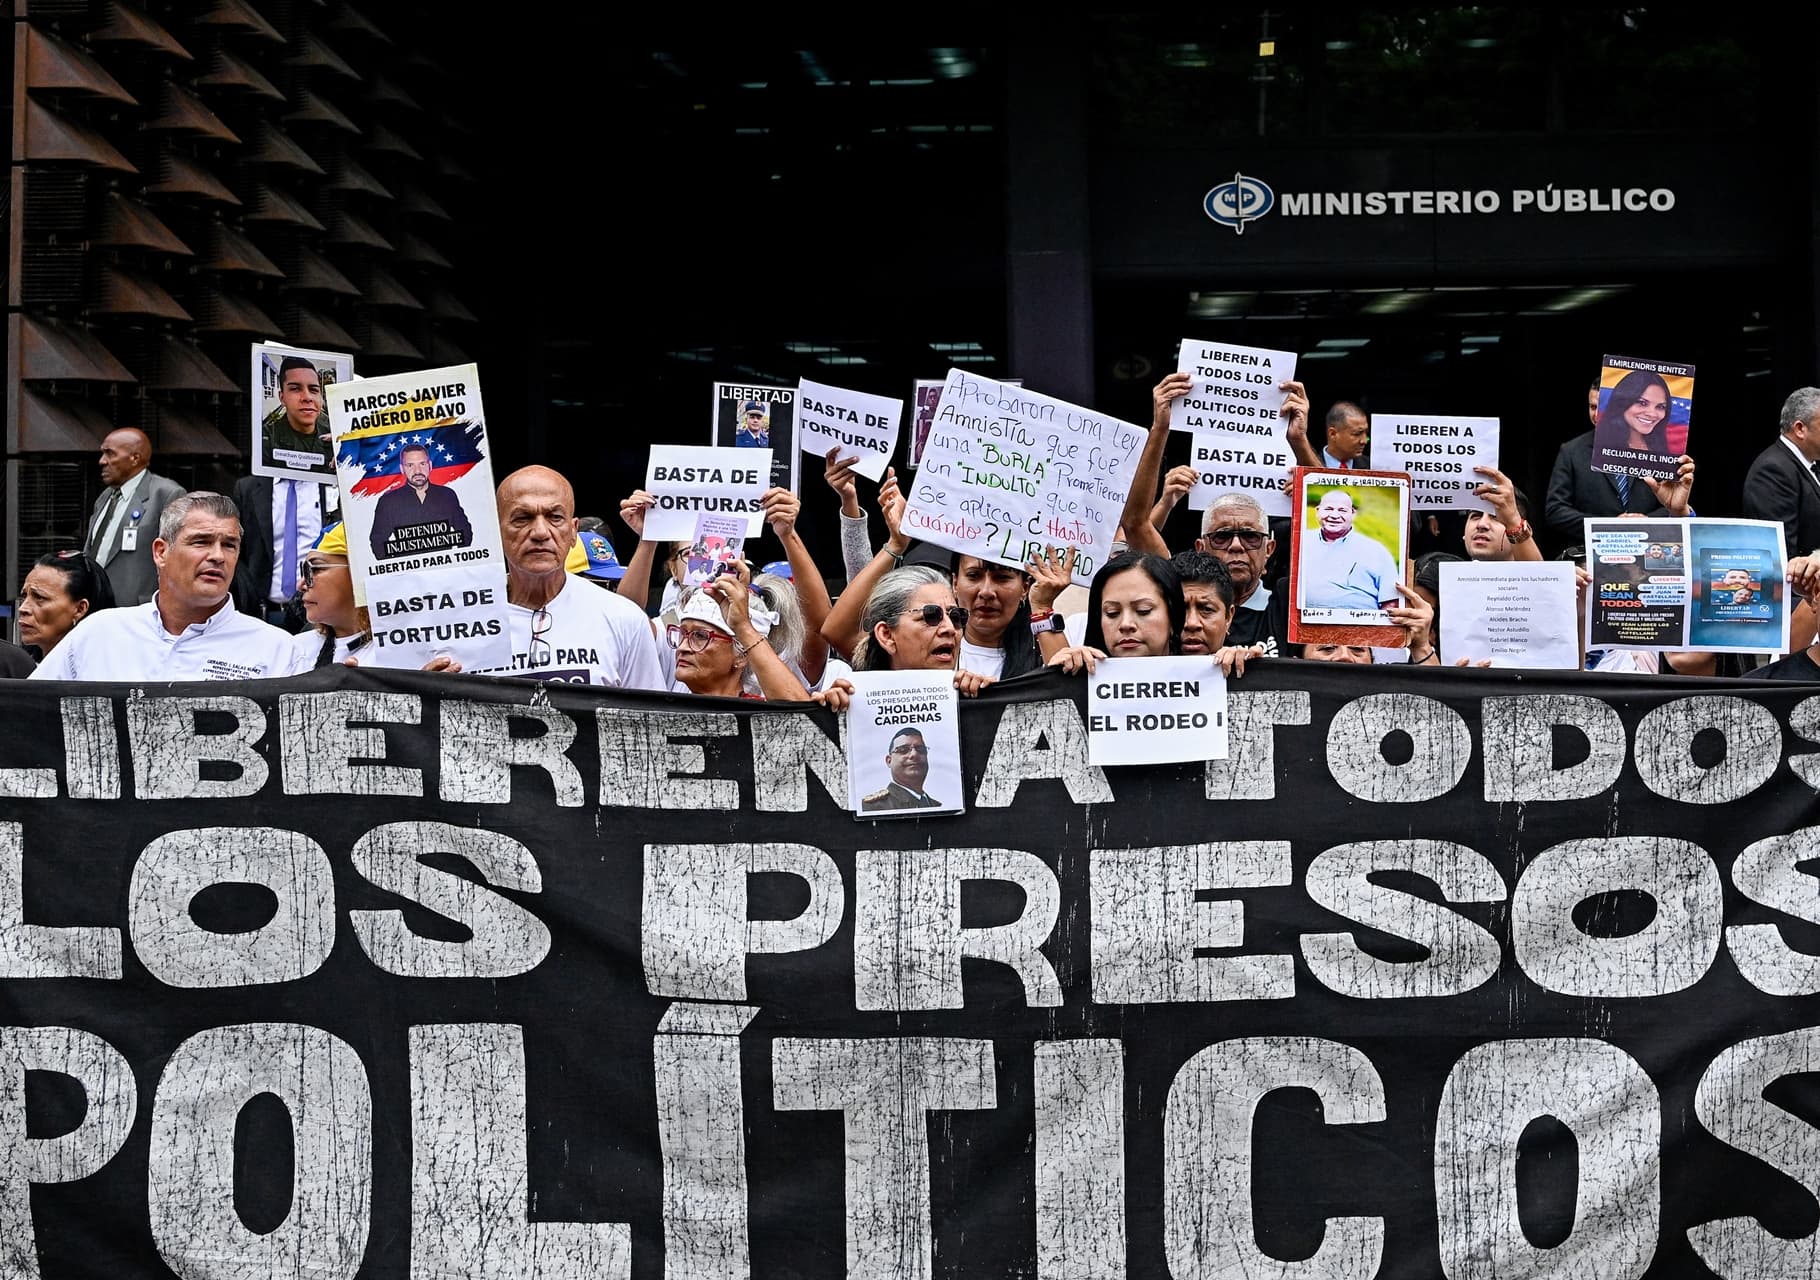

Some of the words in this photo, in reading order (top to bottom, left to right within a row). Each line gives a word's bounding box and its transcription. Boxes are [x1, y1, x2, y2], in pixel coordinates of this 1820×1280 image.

[1281, 190, 1500, 216] MINISTERIO
[1512, 183, 1675, 213] PÚBLICO
[1201, 349, 1259, 366] LIBEREN
[1262, 358, 1272, 368] A
[1609, 359, 1656, 371] EMIRLENDRIS
[1196, 366, 1241, 381] TODOS
[1246, 373, 1272, 385] LOS
[343, 391, 407, 413] MARCOS
[411, 383, 466, 403] JAVIER
[721, 386, 792, 404] LIBERTAD
[948, 373, 1055, 423] Aprobaron
[1205, 385, 1259, 400] PRESOS
[350, 409, 411, 431] AGÜERO
[414, 402, 466, 422] BRAVO
[803, 397, 859, 424] BASTA
[865, 414, 889, 430] DE
[1183, 398, 1255, 417] POLITICOS
[1260, 408, 1278, 420] DE
[800, 418, 889, 454] TORTURAS
[1186, 416, 1203, 427] LA
[1208, 418, 1273, 437] YAGUARA
[1396, 425, 1459, 437] LIBEREN
[1464, 427, 1474, 437] A
[933, 432, 971, 454] una
[1393, 442, 1443, 454] TODOS
[1447, 445, 1476, 455] LOS
[1047, 434, 1079, 460] que
[1088, 447, 1120, 474] fue
[1197, 448, 1257, 464] BASTA
[1263, 453, 1287, 467] DE
[1602, 448, 1637, 460] RECLUIDA
[1638, 453, 1648, 461] EN
[1649, 454, 1658, 462] EL
[654, 467, 724, 484] BASTA
[730, 469, 758, 485] DE
[1405, 461, 1463, 473] PRESOS
[1603, 463, 1628, 474] DESDE
[1629, 467, 1674, 480] 05/08/2018
[926, 458, 951, 477] un
[1047, 492, 1078, 516] que
[1085, 505, 1103, 524] no
[1199, 472, 1288, 491] ORTURAS
[1411, 480, 1460, 490] ITICOS
[650, 495, 761, 513] TORTURAS
[1414, 495, 1453, 504] YARE
[397, 522, 448, 540] DETENIDO
[386, 532, 463, 554] INJUSTAMENTE
[369, 559, 421, 576] LIBERTAD
[423, 554, 452, 568] PARA
[454, 549, 490, 563] TODOS
[376, 594, 455, 617] BASTA
[463, 588, 494, 607] DE
[374, 619, 501, 648] TORTURAS
[556, 649, 600, 665] PARA
[866, 688, 901, 698] LIBERTAD
[923, 686, 948, 694] TODOS
[867, 698, 881, 706] LOS
[882, 697, 911, 705] PRESOS
[912, 694, 949, 702] POLITICOS
[1096, 681, 1200, 700] CIERREN
[877, 702, 938, 715] JHOLMAR
[874, 712, 942, 726] CARDENAS
[1090, 715, 1118, 732] EL
[1126, 713, 1208, 731] RODEO
[975, 699, 1115, 808] A
[1205, 690, 1820, 805] TODO
[0, 820, 552, 989] LOS
[0, 1001, 1820, 1280] POLÍTICOS
